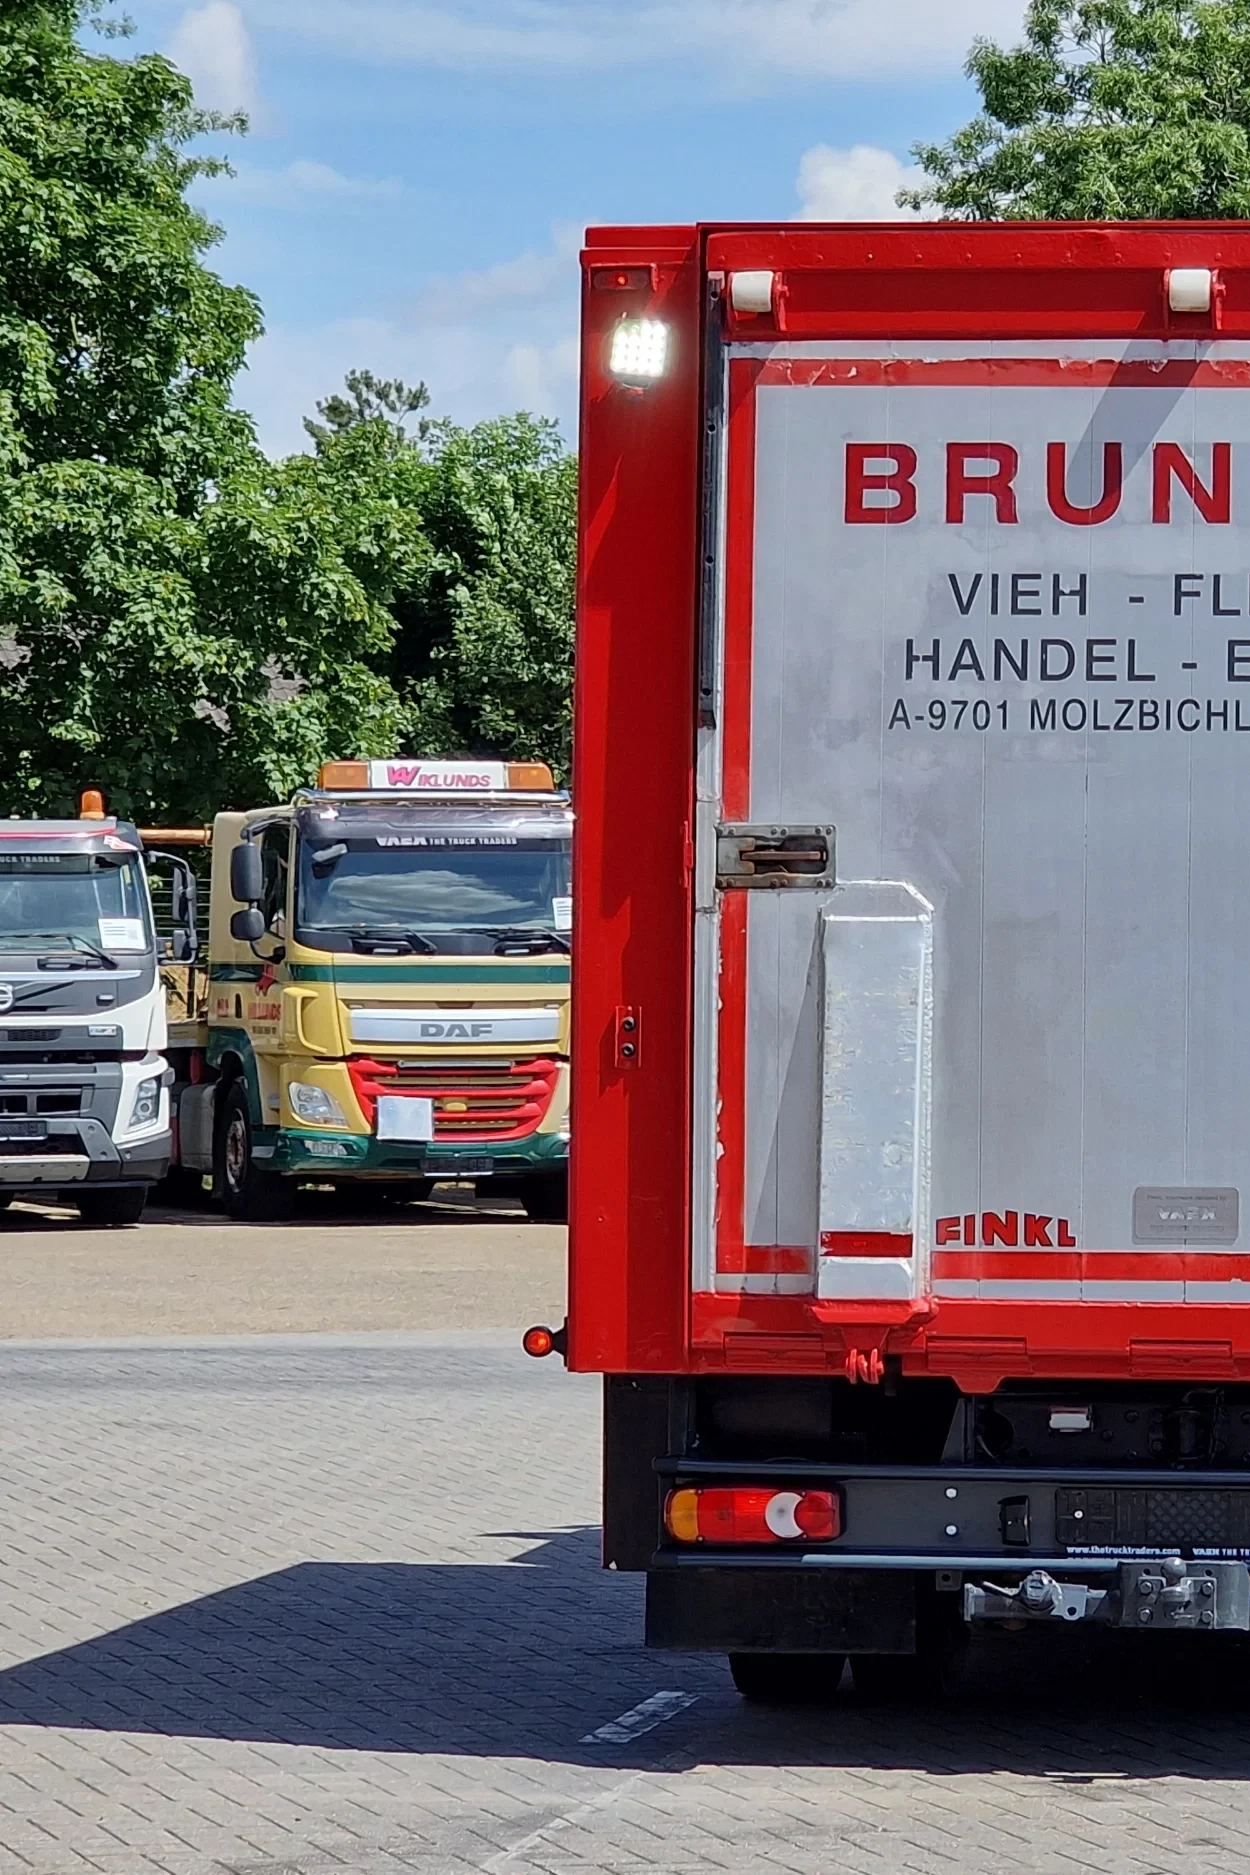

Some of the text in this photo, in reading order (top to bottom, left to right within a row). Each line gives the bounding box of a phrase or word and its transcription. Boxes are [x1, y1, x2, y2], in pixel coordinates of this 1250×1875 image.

[947, 573, 1088, 616] VIEH
[904, 638, 1156, 683] HANDEL
[888, 699, 1009, 732] A-9701
[386, 765, 491, 788] WIKLUNDS
[429, 837, 446, 846] THE
[447, 837, 476, 846] TRUCK
[478, 837, 518, 846] TRADERS
[20, 855, 61, 863] TRADERS
[420, 1023, 493, 1038] DAF
[935, 1210, 1077, 1248] FINKL
[1221, 1548, 1237, 1556] THE
